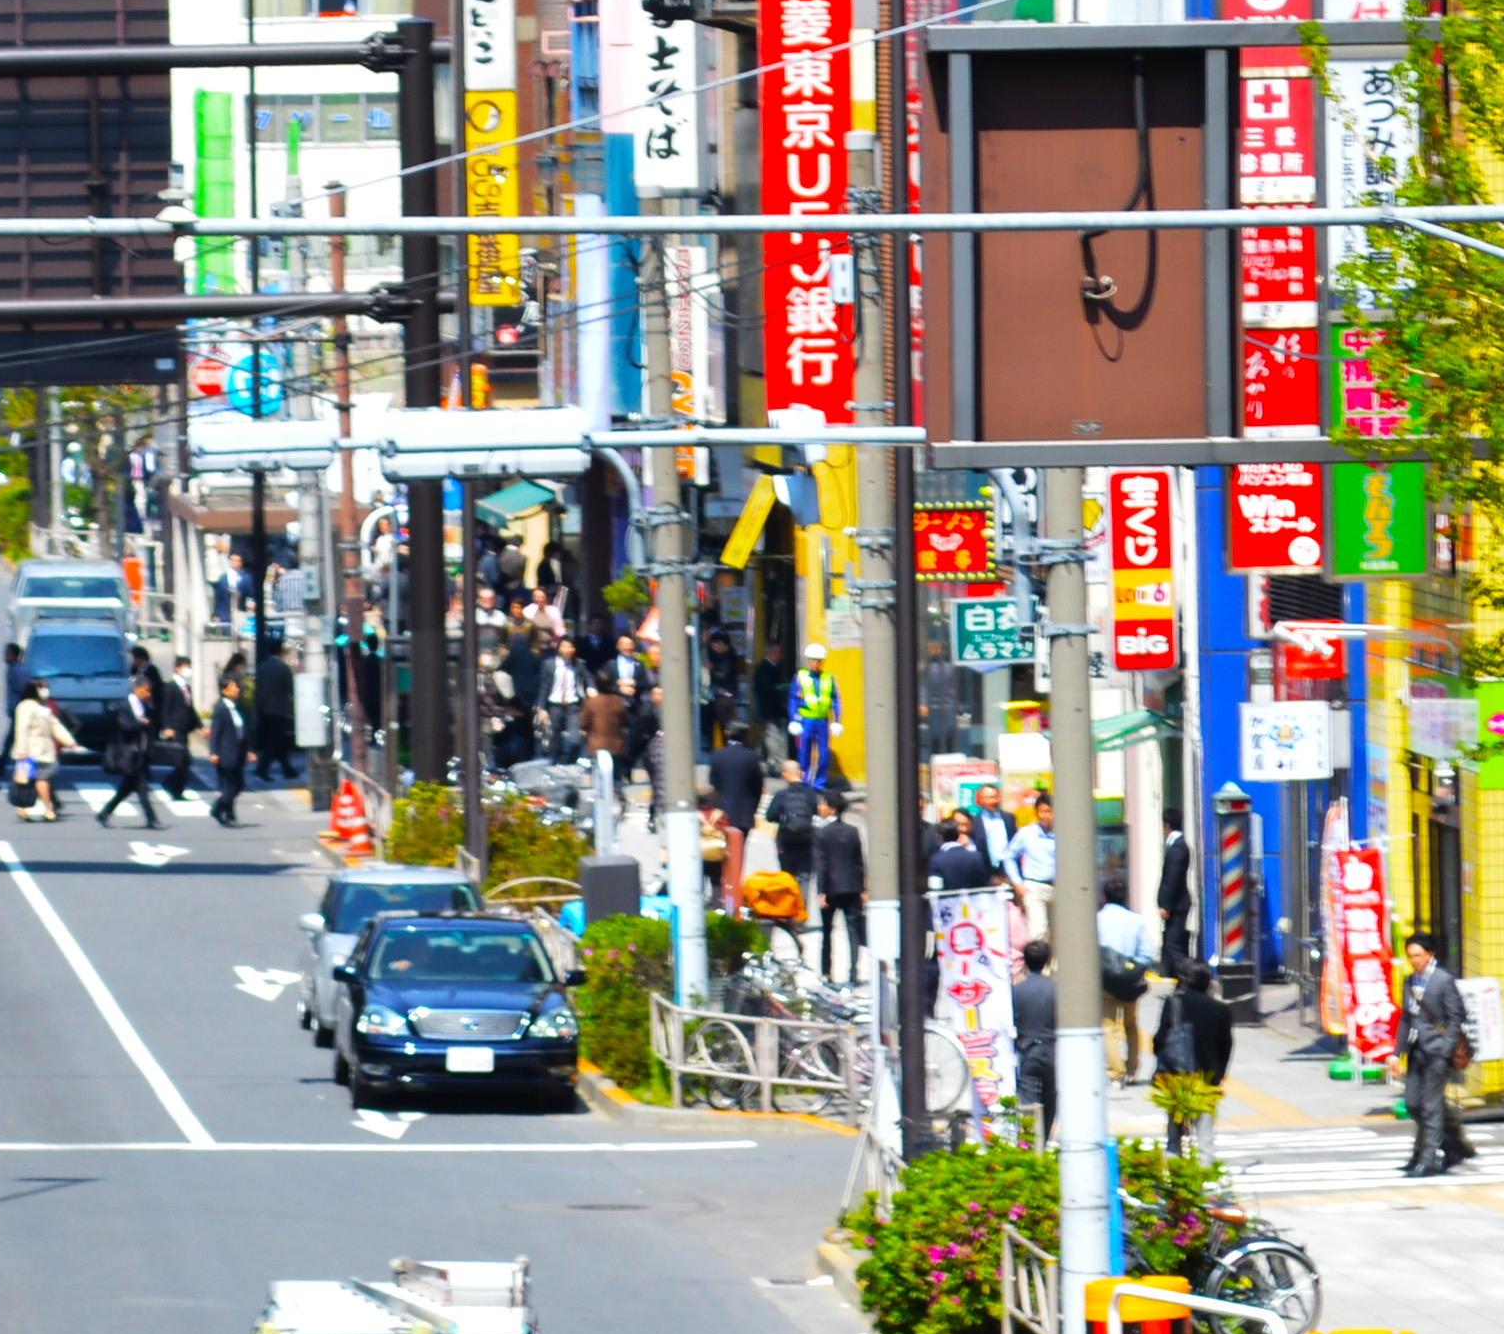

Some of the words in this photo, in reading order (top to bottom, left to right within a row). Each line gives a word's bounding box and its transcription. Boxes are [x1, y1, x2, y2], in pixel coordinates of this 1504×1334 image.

[646, 10, 690, 160] 士そば
[1120, 476, 1160, 566] 宝くじ
[1237, 494, 1296, 518] Win
